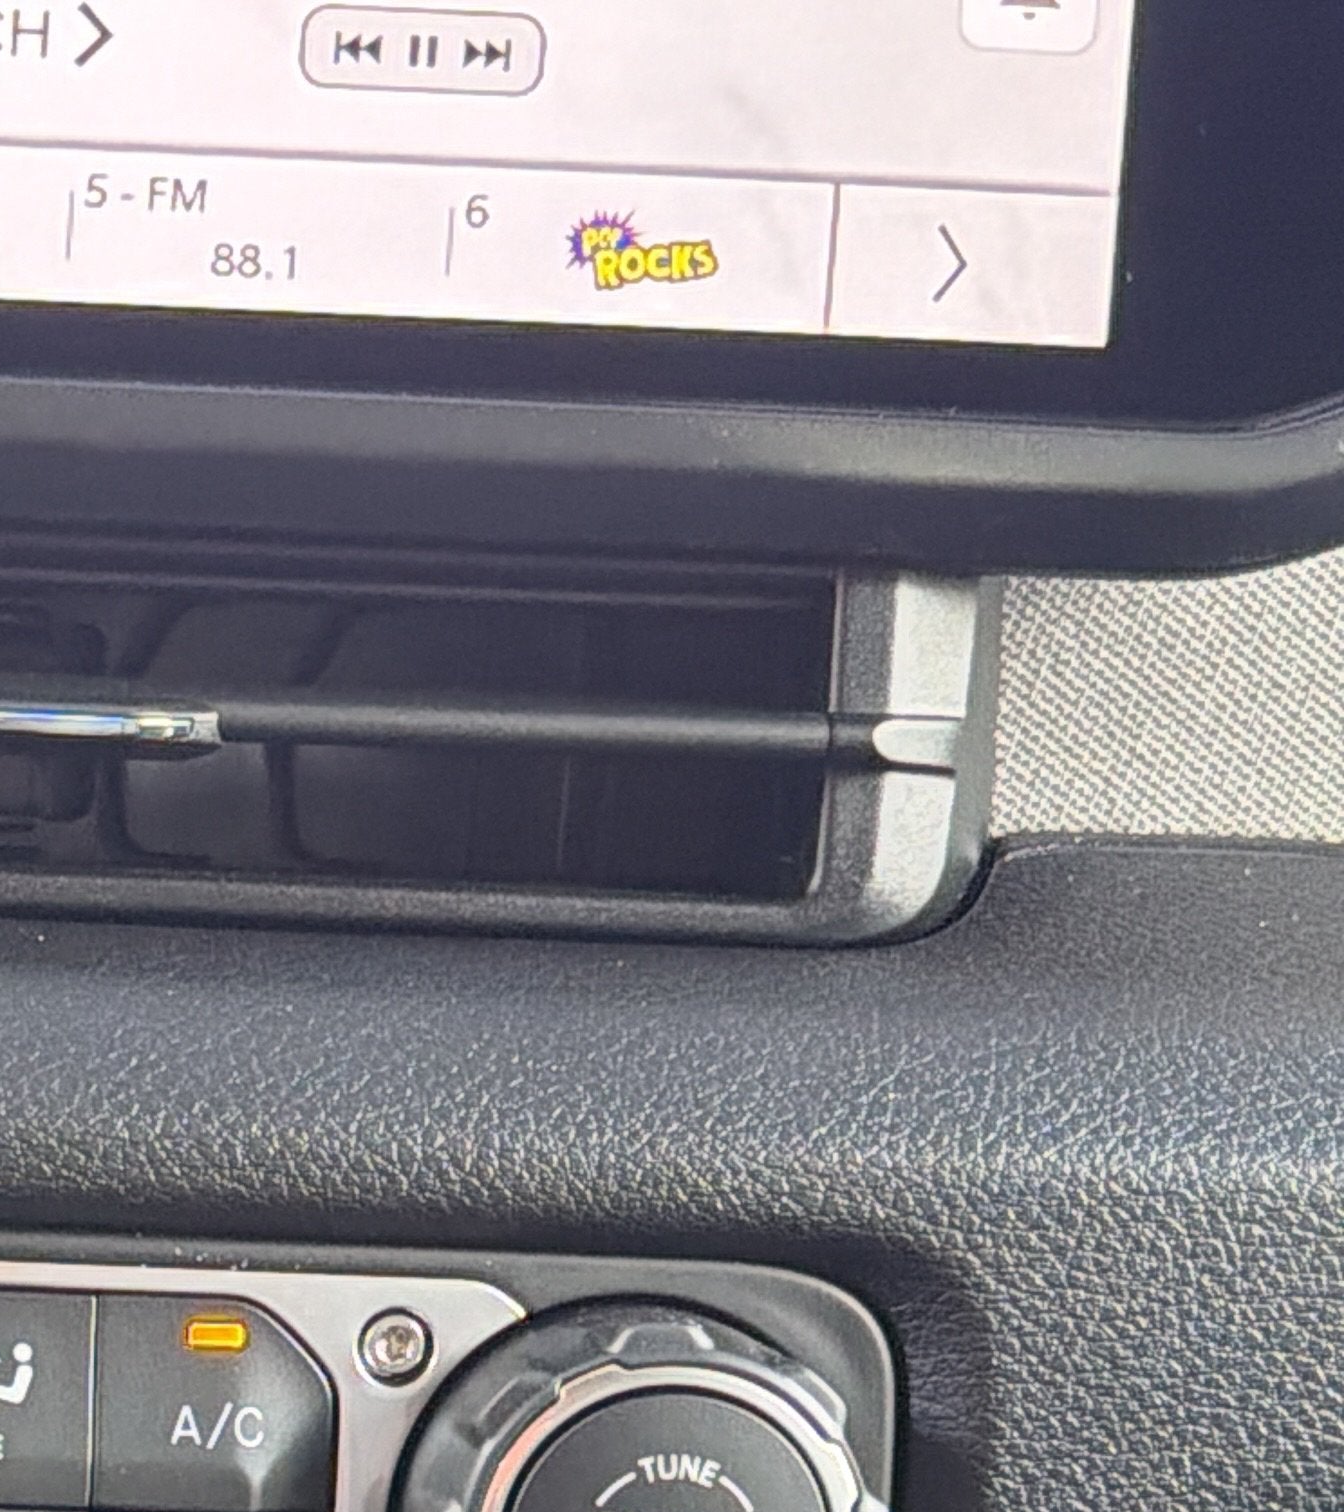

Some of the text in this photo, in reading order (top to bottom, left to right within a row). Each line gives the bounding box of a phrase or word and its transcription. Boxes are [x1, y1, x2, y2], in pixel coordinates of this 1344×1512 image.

[83, 173, 108, 209] 5
[148, 178, 208, 213] FM
[465, 194, 490, 229] 6
[211, 243, 297, 280] 88.1
[593, 241, 719, 290] ROCKS
[170, 1402, 266, 1449] A/C
[637, 1454, 722, 1487] TUNE
